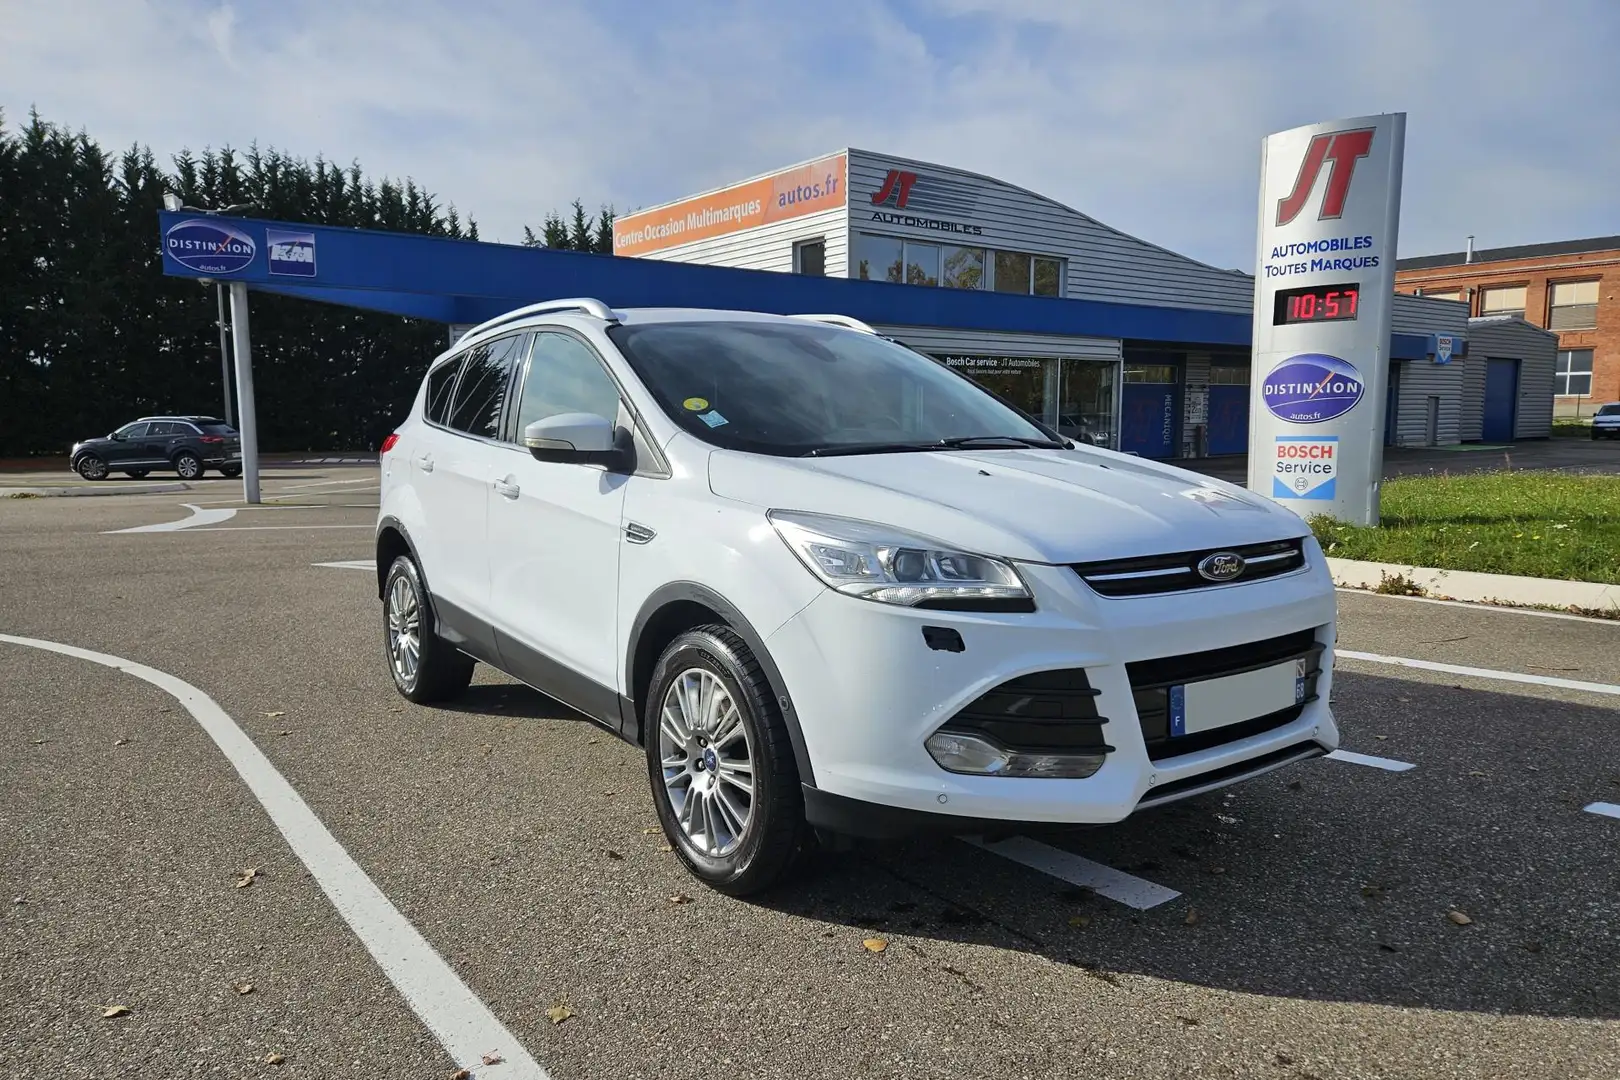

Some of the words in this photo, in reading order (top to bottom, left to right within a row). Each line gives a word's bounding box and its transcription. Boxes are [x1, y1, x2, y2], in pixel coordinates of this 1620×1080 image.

[871, 168, 917, 208] JT
[1275, 126, 1377, 228] JT
[778, 173, 839, 208] autos.fr
[615, 231, 643, 249] Centre
[644, 218, 685, 241] Occasion
[687, 200, 761, 231] Multimarques
[871, 212, 983, 236] AUTOMOBILES
[169, 238, 252, 255] DISTINXION
[1271, 236, 1373, 260] AUTOMOBILES
[1265, 261, 1307, 278] TOUTES
[1310, 256, 1379, 272] MARQUES
[1292, 290, 1359, 319] 10:57
[946, 357, 965, 367] Bosch
[965, 357, 976, 367] Car
[976, 358, 997, 367] service
[1008, 358, 1040, 368] Automobiles
[1265, 381, 1358, 396] DISTINXION
[1162, 394, 1173, 446] MECANIQUE
[1290, 411, 1321, 421] autos.fr
[1277, 445, 1333, 459] BOSCH
[1276, 461, 1332, 474] Service
[1213, 556, 1239, 575] Ford
[1174, 716, 1181, 727] F
